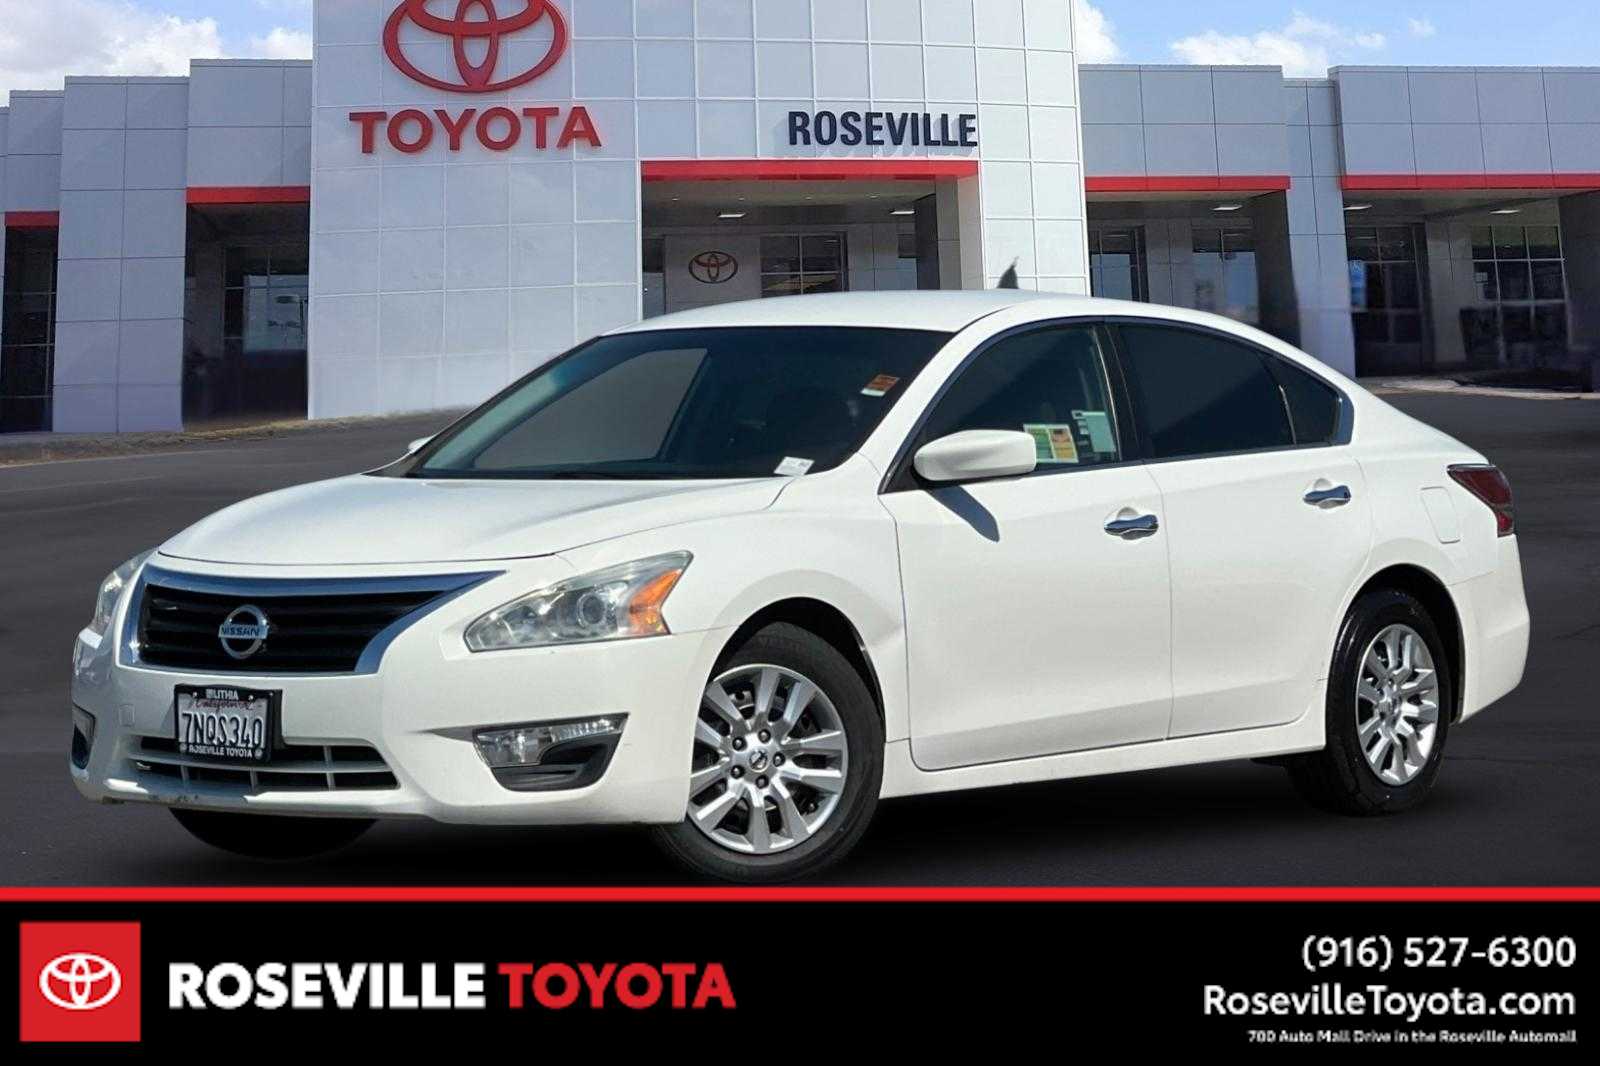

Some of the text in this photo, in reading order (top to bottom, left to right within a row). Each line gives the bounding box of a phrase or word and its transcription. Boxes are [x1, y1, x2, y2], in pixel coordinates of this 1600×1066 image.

[349, 106, 602, 153] TOYOTA
[789, 111, 978, 148] ROSEVILLE
[221, 625, 260, 636] NISSAN
[214, 690, 239, 701] LITHIA
[182, 712, 263, 749] 7NQS340
[188, 745, 253, 758] ROSEVILLE TOYOTA
